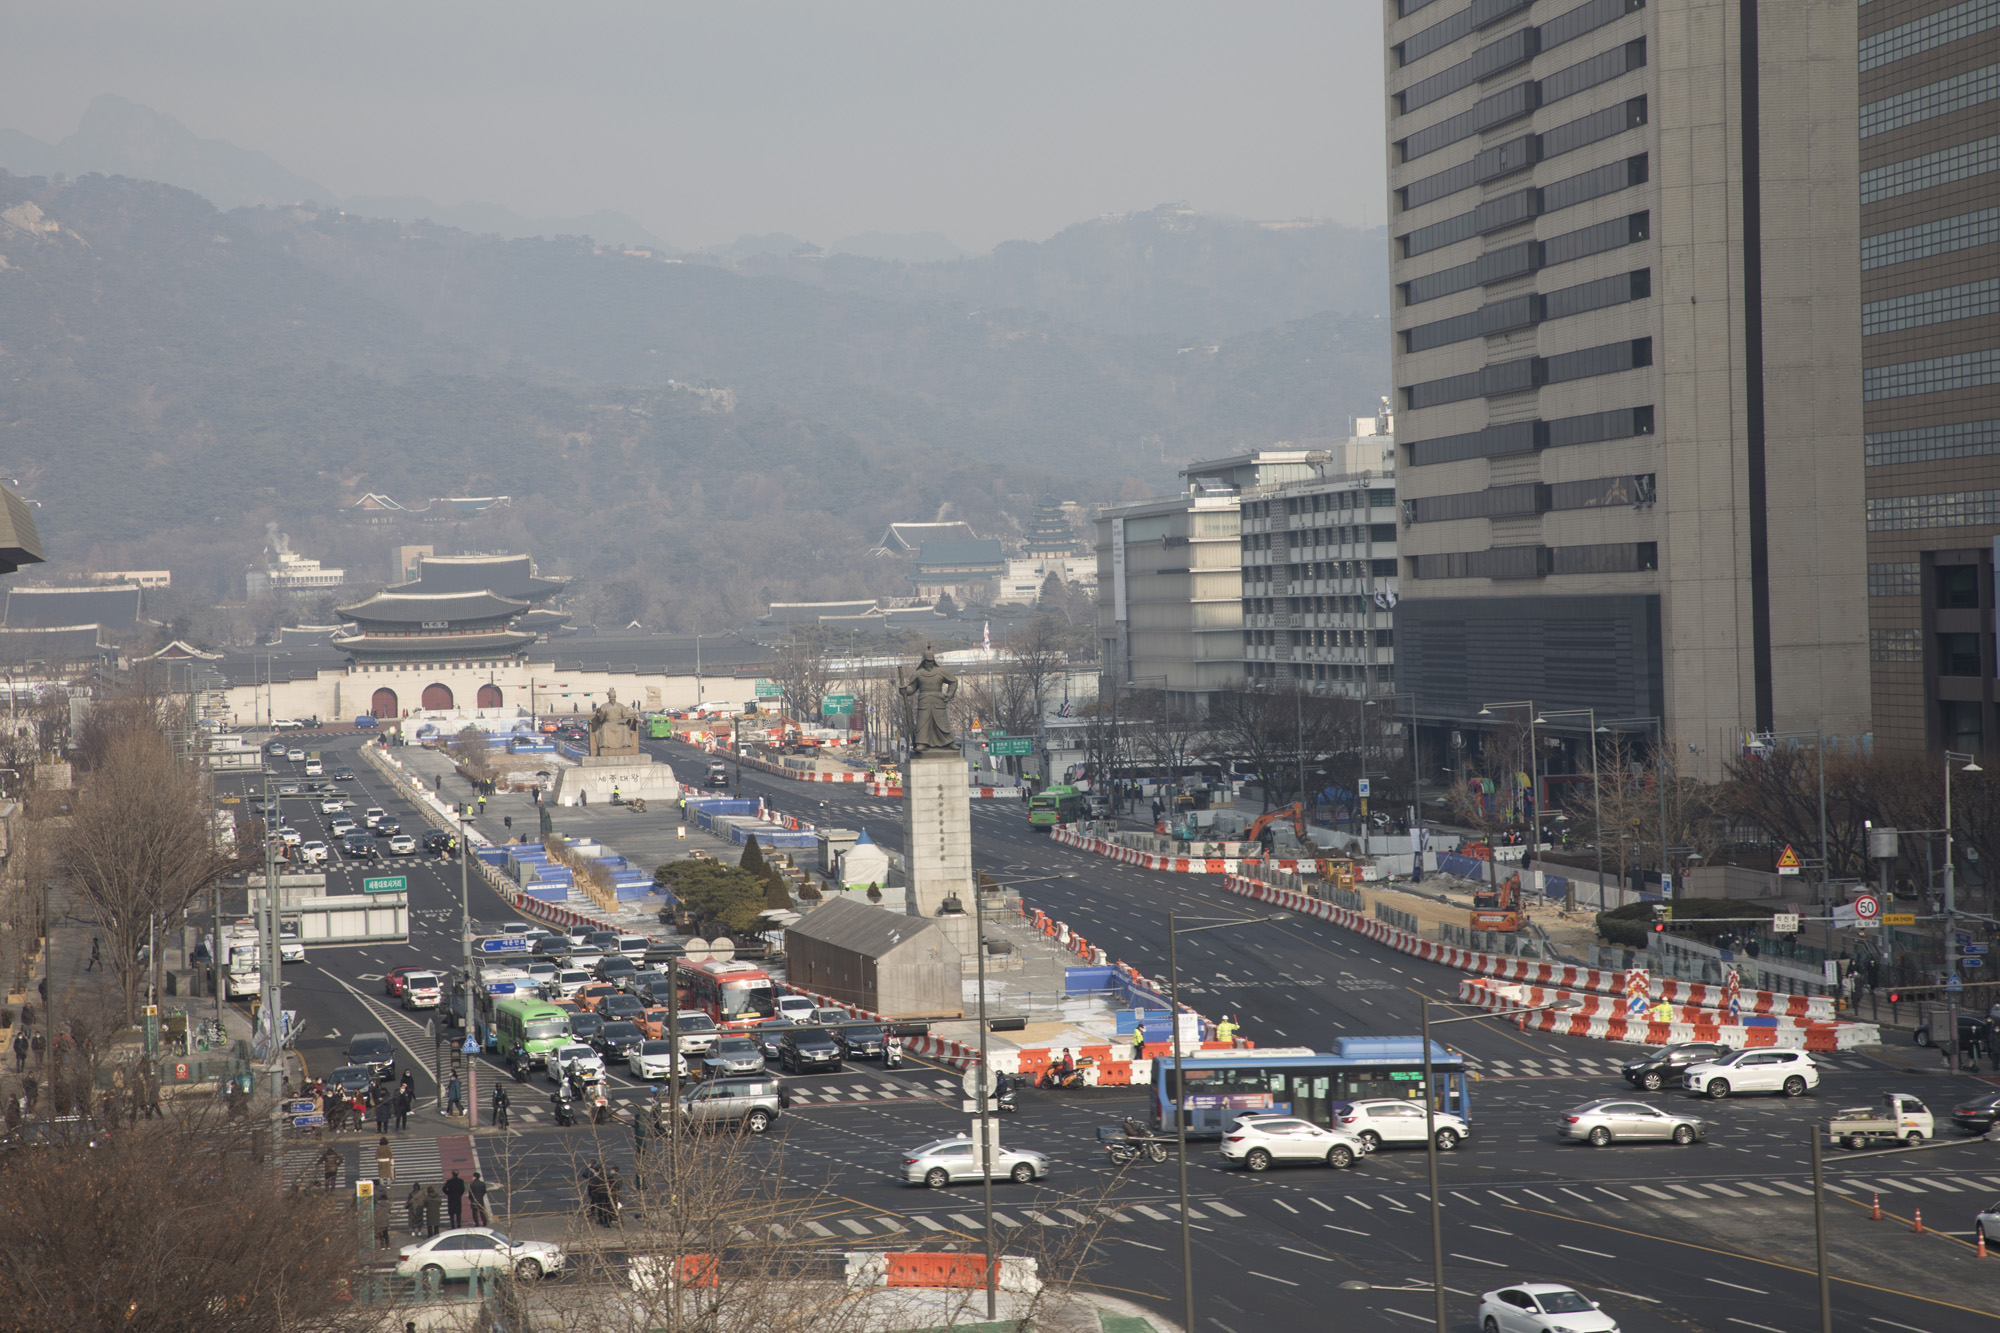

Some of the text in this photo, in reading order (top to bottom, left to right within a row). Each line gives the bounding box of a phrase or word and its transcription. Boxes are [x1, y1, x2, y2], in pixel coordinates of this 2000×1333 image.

[598, 773, 639, 783] 세종대왕
[368, 879, 402, 889] 세종대로사거리
[1860, 901, 1874, 914] 50
